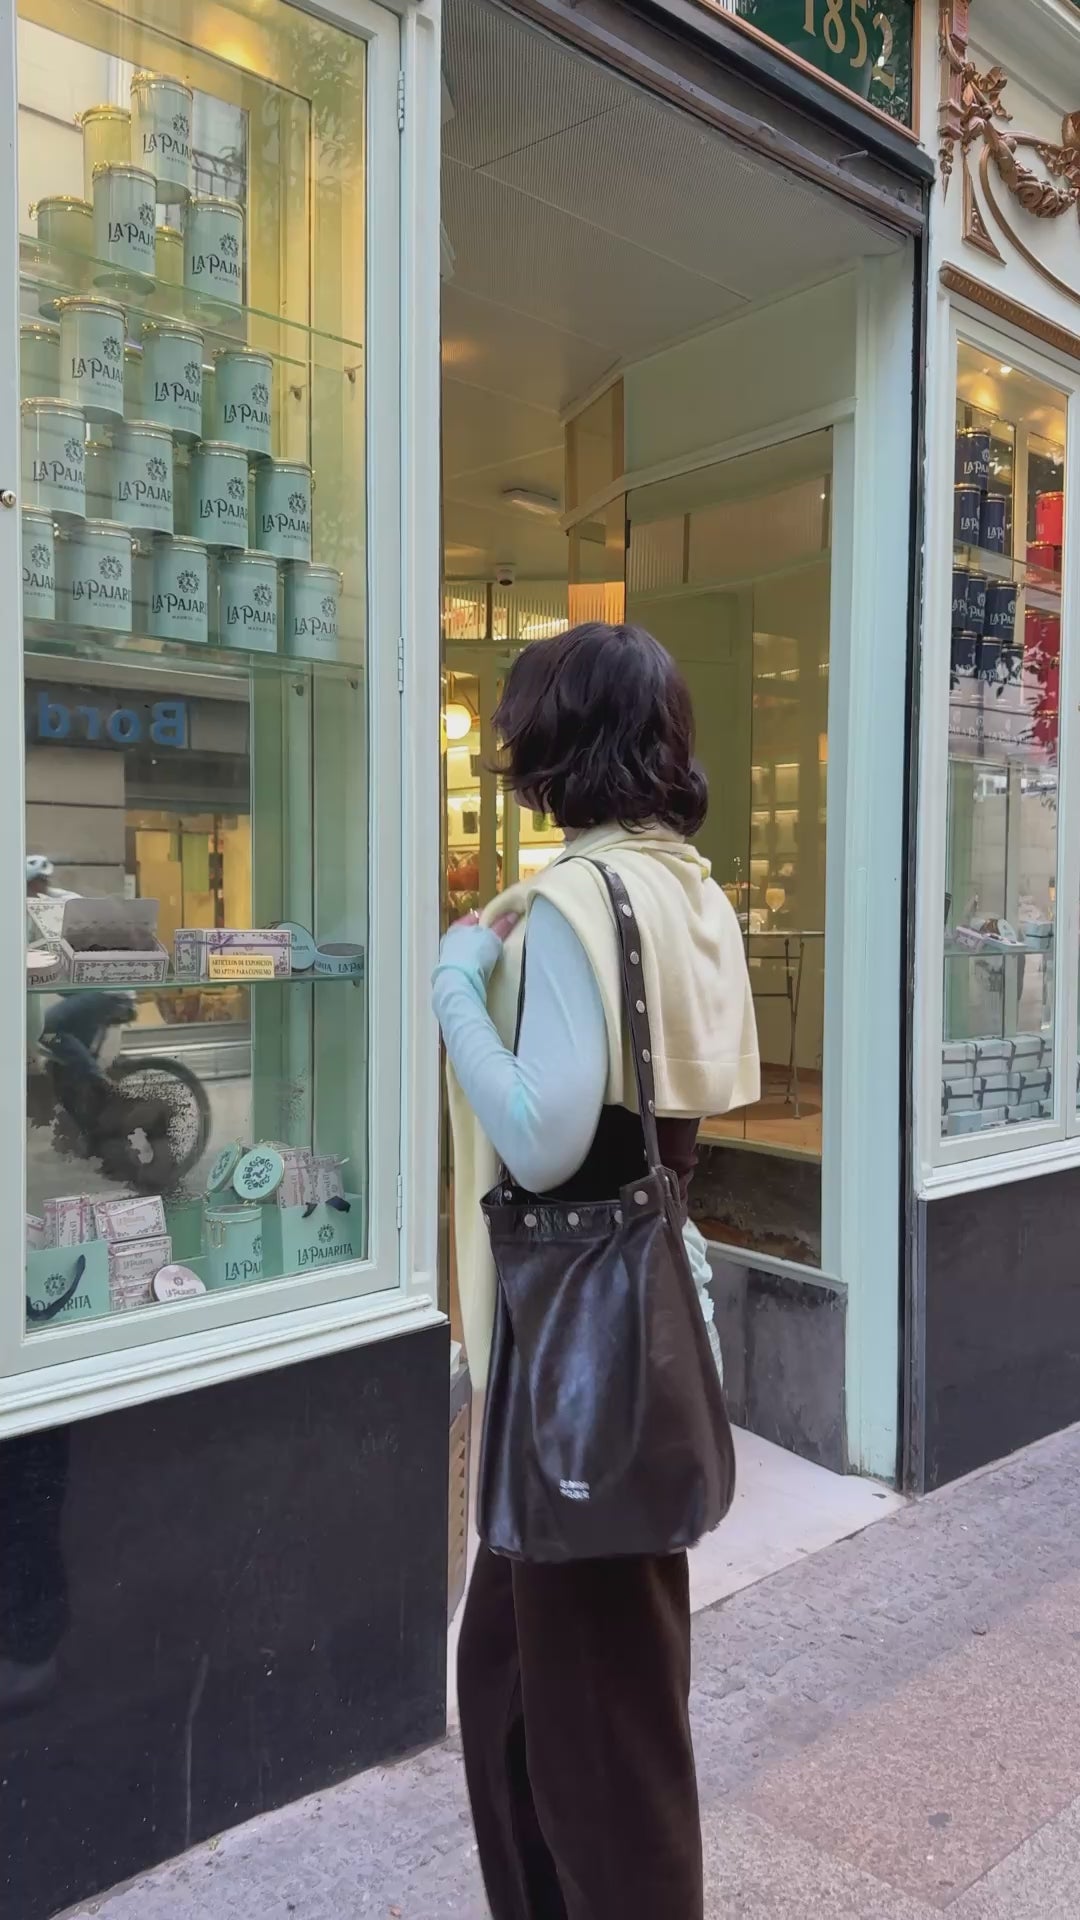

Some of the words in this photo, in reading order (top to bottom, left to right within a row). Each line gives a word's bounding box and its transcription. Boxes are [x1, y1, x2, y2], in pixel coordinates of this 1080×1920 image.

[803, 0, 896, 94] 1852
[143, 133, 157, 153] LA
[108, 222, 124, 243] LA
[191, 255, 205, 275] LA
[72, 357, 86, 379] LA
[154, 381, 169, 402] LA
[223, 404, 237, 424] LA
[33, 460, 48, 482] LA
[963, 461, 974, 475] LA
[118, 480, 132, 501] LA
[200, 499, 215, 519] LA
[262, 513, 275, 533] LA
[961, 517, 970, 530] LA
[987, 526, 997, 539] LA
[72, 580, 84, 600] LA
[152, 593, 164, 613] LA
[226, 605, 239, 625] LA
[989, 612, 999, 626] LA
[294, 617, 308, 635] LA
[298, 1248, 308, 1266] LA
[308, 1243, 353, 1264] PAJARITA
[225, 1262, 240, 1281] LA
